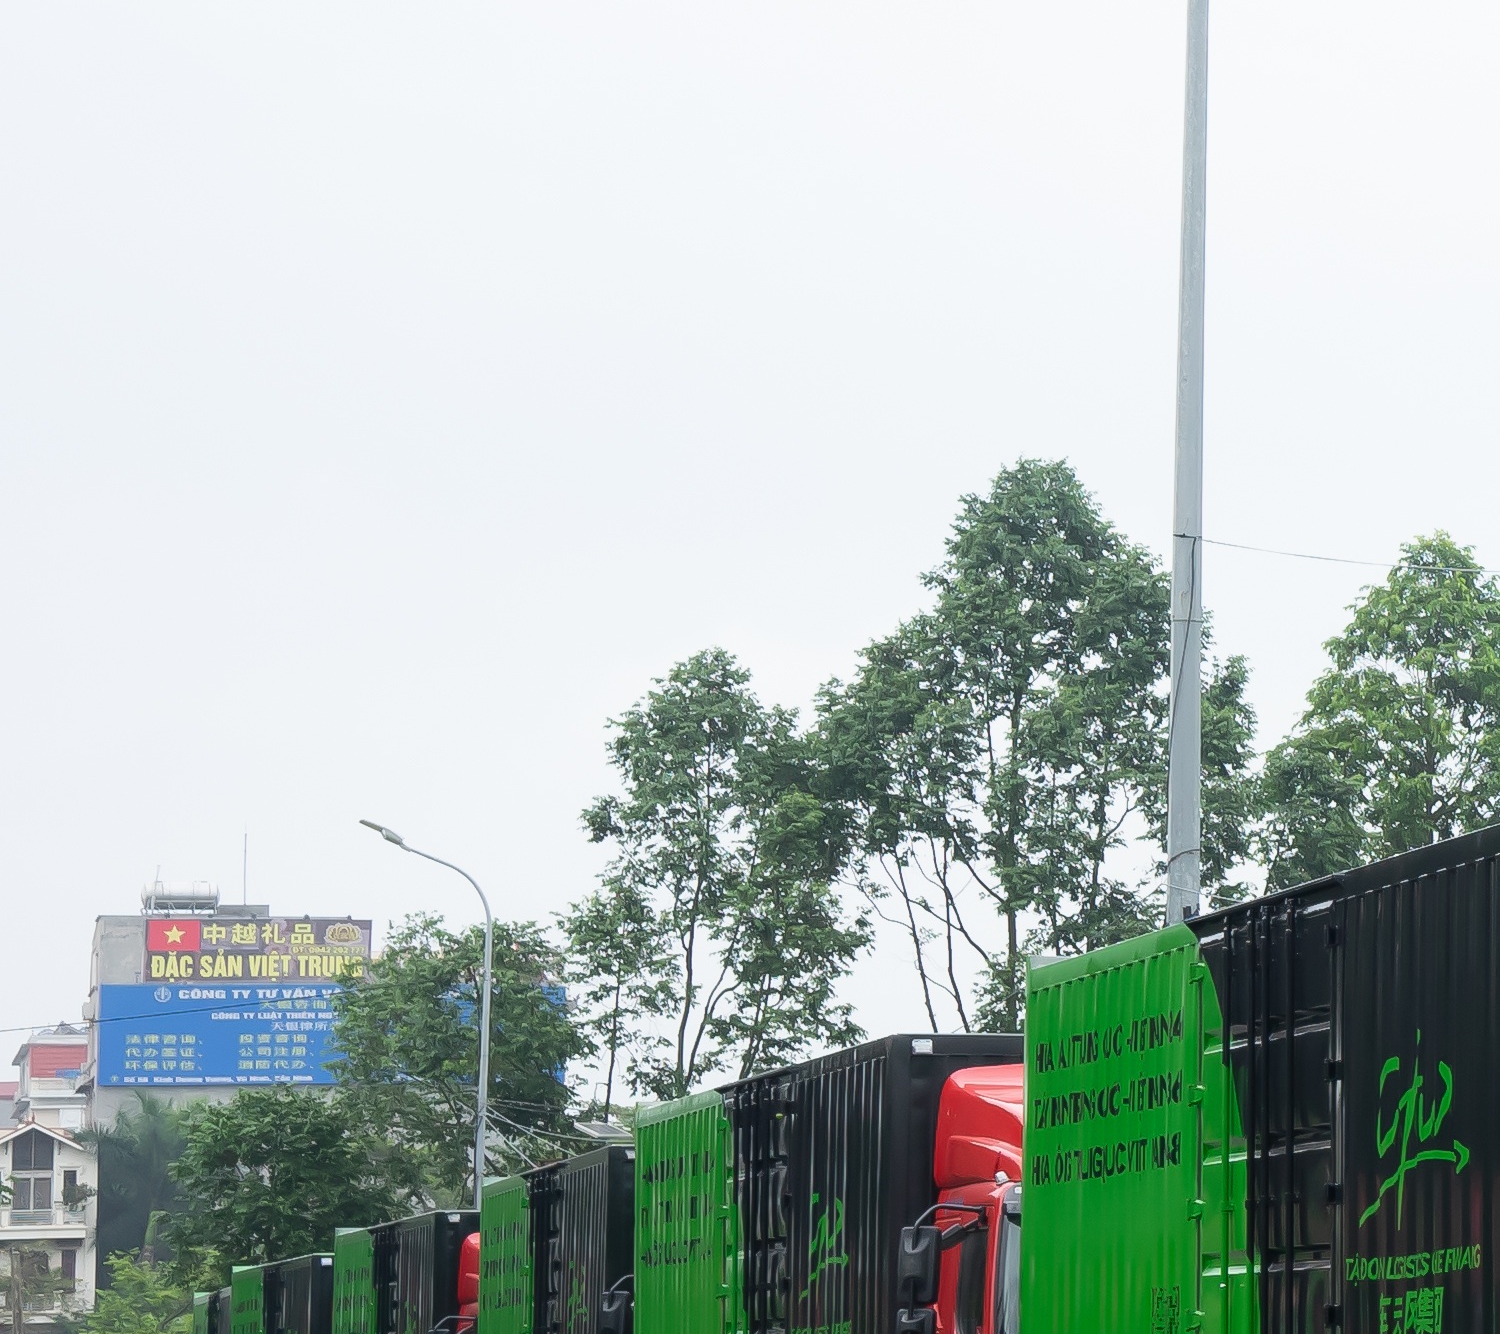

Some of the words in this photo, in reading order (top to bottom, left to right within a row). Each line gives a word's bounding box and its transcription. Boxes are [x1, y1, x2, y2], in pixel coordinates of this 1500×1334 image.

[203, 922, 315, 945] 中越礼品
[151, 951, 193, 983] ĐẶC
[200, 948, 243, 979] SẢN
[249, 951, 292, 982] VIỆT
[178, 988, 226, 999] CÔNG
[232, 989, 250, 999] TY
[256, 988, 279, 999] TƯ
[211, 1011, 240, 1020] CÔNG
[243, 1011, 255, 1020] TY
